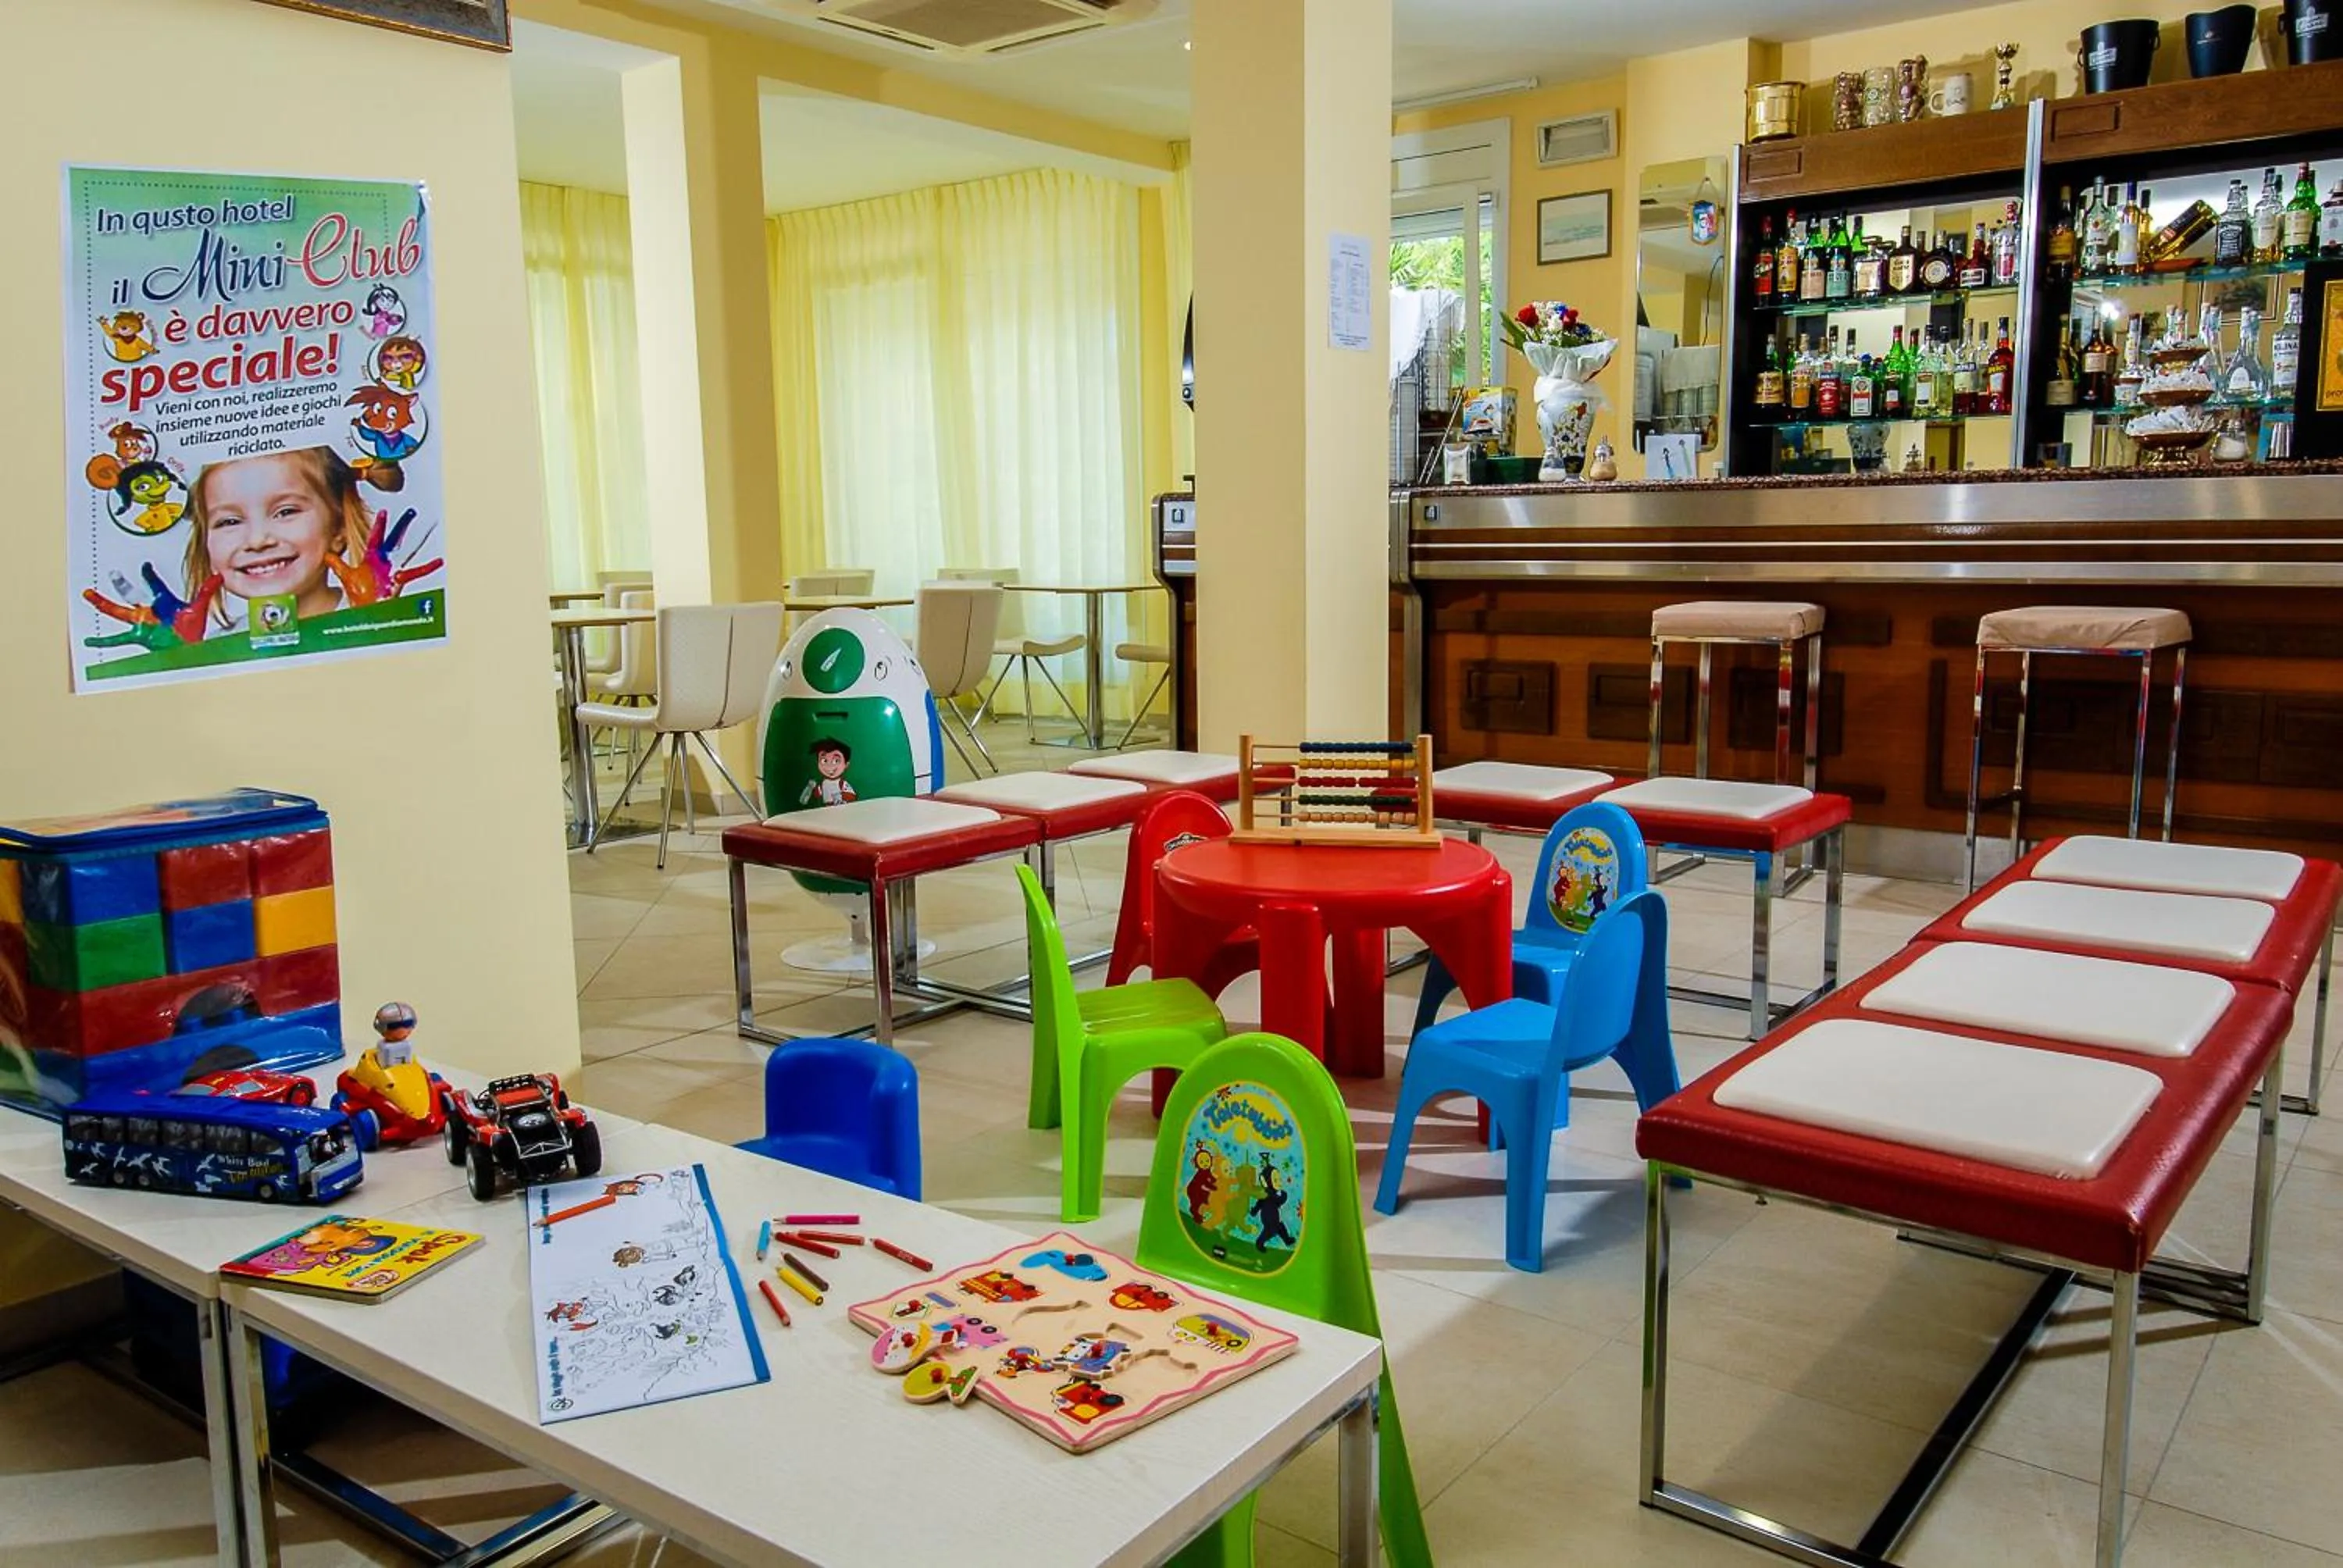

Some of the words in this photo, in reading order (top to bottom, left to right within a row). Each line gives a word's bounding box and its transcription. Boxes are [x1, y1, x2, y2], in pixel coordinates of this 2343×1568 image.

[97, 208, 125, 232] In
[132, 205, 215, 235] qusto
[222, 195, 292, 223] hotel
[112, 279, 128, 305] il
[141, 228, 284, 302] Mini
[287, 212, 421, 287] Club
[164, 311, 187, 343] è
[197, 300, 354, 340] davvero
[100, 333, 339, 412] speciale!
[155, 399, 191, 415] Vieni
[194, 397, 220, 410] con
[223, 392, 249, 407] noi,
[252, 382, 338, 404] realizzeremo
[155, 415, 212, 433] insieme
[215, 410, 259, 425] nuove
[261, 404, 290, 418] idee
[291, 404, 300, 414] e
[302, 394, 341, 415] giochi
[180, 425, 259, 447] utilizzando
[261, 414, 326, 434] materiale
[228, 438, 286, 456] riciclato.
